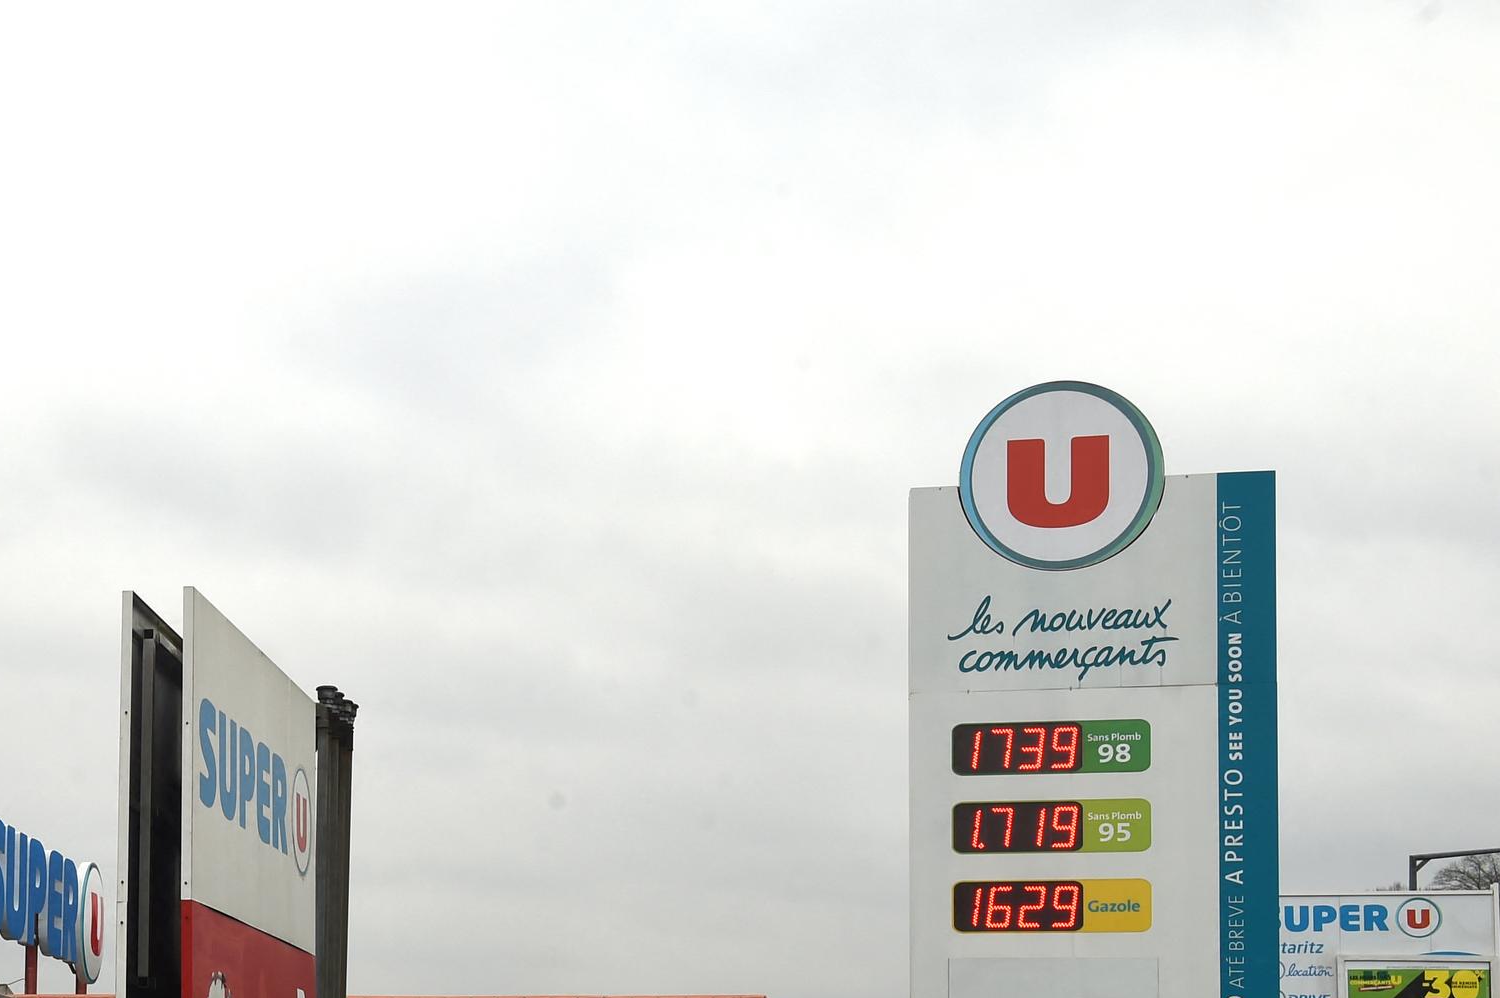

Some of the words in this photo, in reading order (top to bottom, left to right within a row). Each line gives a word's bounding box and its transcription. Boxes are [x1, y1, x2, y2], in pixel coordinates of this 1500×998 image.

[1007, 434, 1110, 529] U
[1219, 501, 1242, 604] BIENTÔT
[947, 595, 1004, 640] les
[1012, 598, 1172, 637] nouveaux
[1219, 610, 1242, 625] À
[958, 635, 1180, 681] commerçants
[1228, 632, 1243, 683] SOON
[1228, 689, 1243, 726] YOU
[1087, 733, 1109, 742] Sans
[1111, 732, 1142, 742] Plomb
[1229, 732, 1243, 761] SEE
[1098, 743, 1132, 763] 98
[200, 698, 288, 856] SUPER
[296, 792, 307, 854] U
[1087, 812, 1110, 821] Sans
[1111, 811, 1142, 821] Plomb
[1223, 769, 1244, 862] PRESTO
[1098, 822, 1132, 842] 95
[1224, 869, 1244, 885] A
[1087, 900, 1141, 913] Gazole
[1279, 904, 1390, 932] UPER
[1406, 908, 1431, 930] U
[1228, 895, 1245, 951] BREVE
[1281, 941, 1324, 954] taritz
[1225, 956, 1245, 989] ATÉ
[1285, 962, 1335, 977] location
